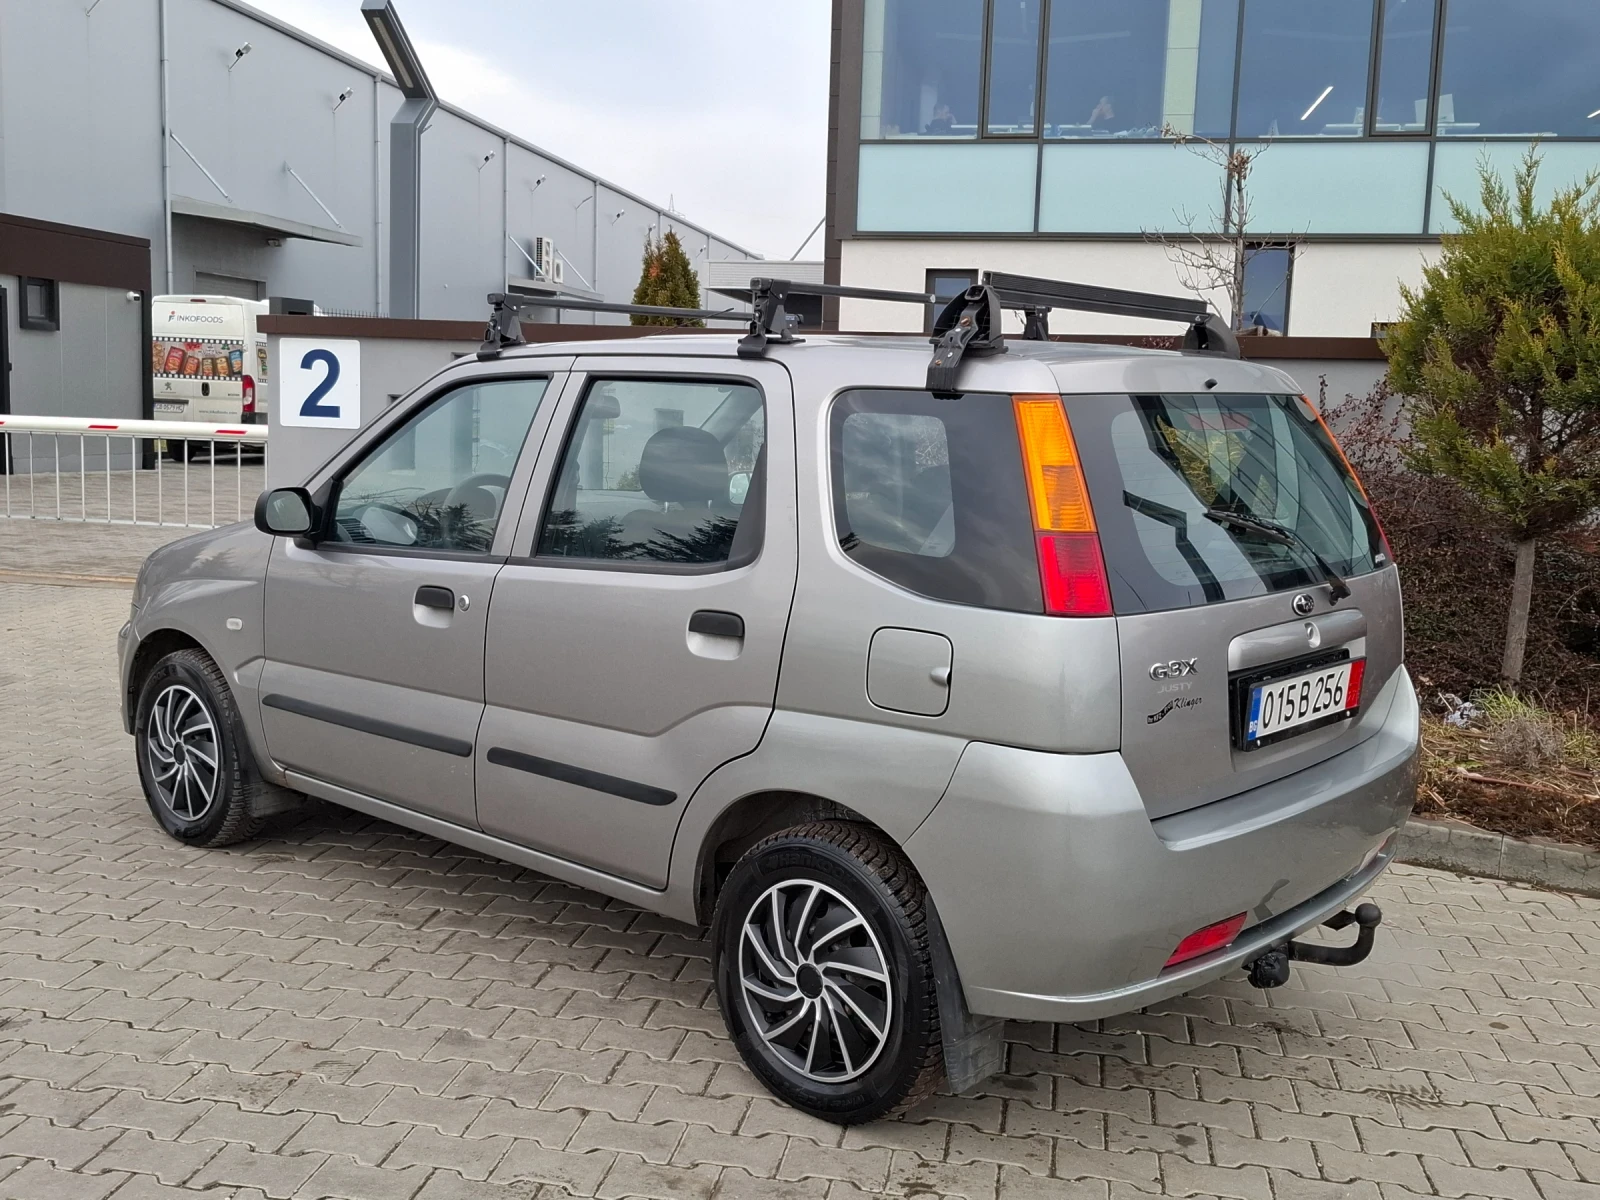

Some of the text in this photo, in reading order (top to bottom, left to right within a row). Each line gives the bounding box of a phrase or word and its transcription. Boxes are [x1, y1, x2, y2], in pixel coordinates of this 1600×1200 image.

[176, 314, 224, 324] INKOFOODS
[299, 348, 341, 419] 2
[1148, 657, 1198, 681] G3X
[1157, 681, 1193, 694] JUSTY
[1173, 697, 1203, 711] Klinger
[1248, 720, 1258, 734] BG
